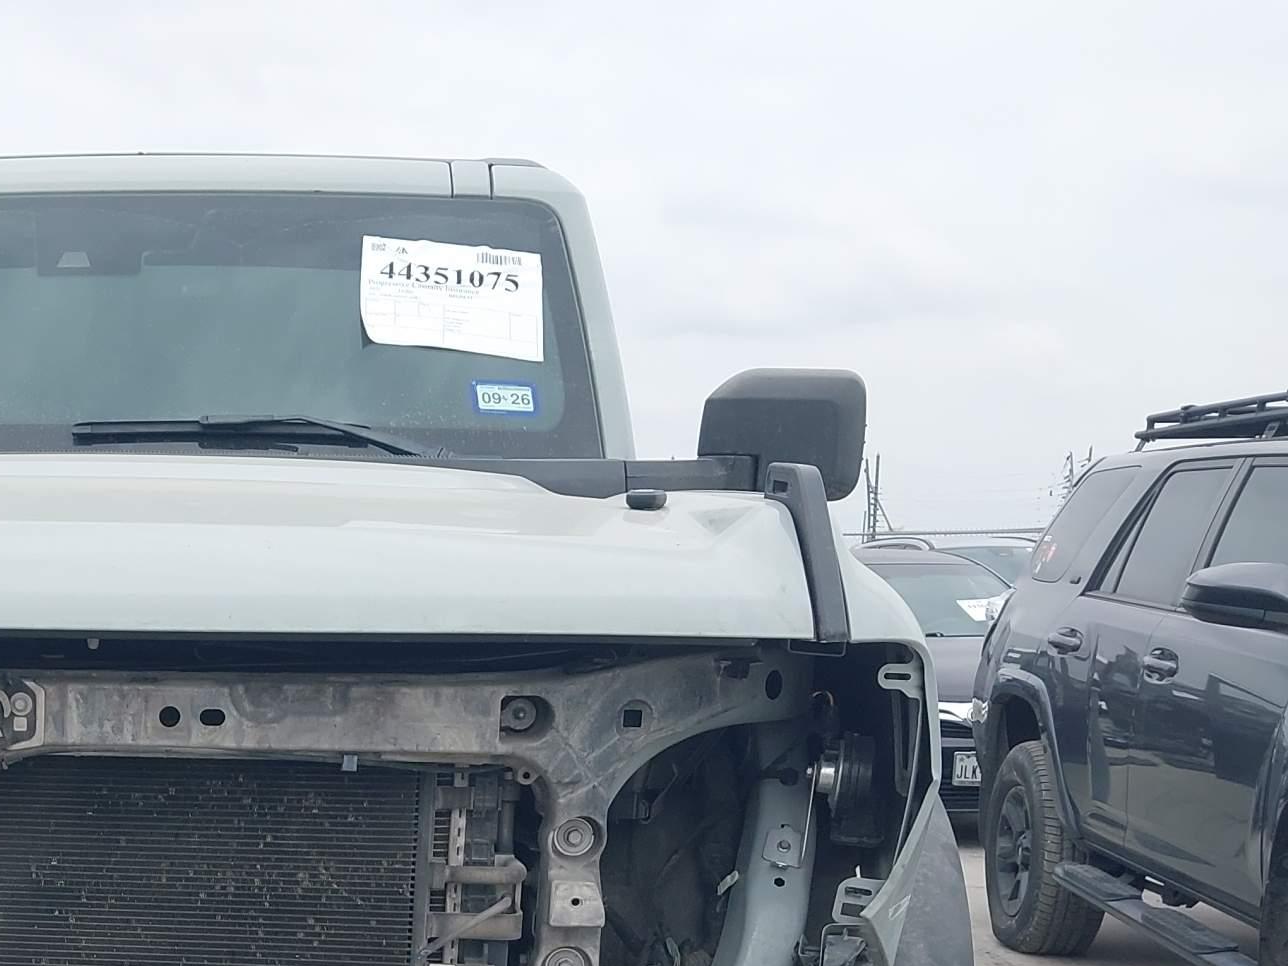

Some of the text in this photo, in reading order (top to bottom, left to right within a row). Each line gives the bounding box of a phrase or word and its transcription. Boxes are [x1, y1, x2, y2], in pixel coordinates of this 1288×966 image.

[379, 261, 519, 293] 44351075
[481, 391, 531, 406] 09 26
